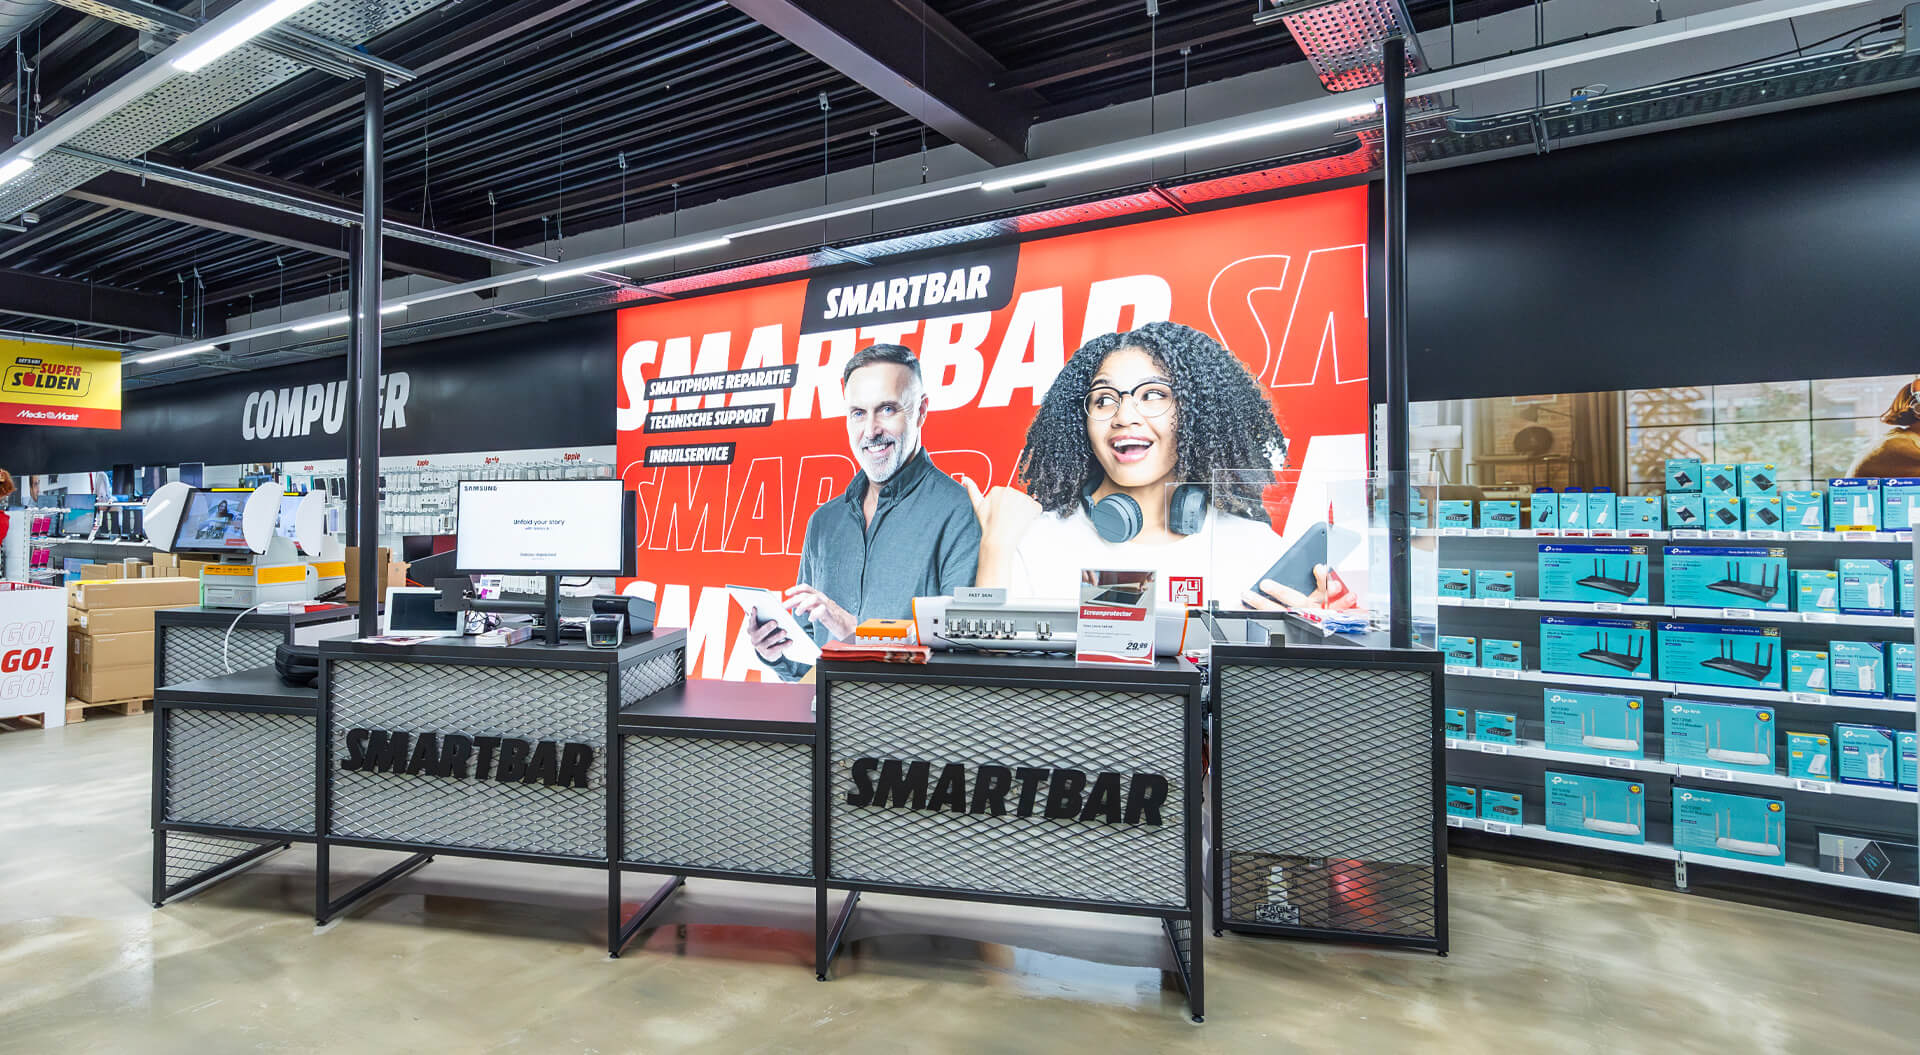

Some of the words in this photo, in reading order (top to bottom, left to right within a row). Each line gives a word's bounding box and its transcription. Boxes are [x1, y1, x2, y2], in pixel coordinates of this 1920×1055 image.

[824, 264, 991, 319] SMARTBAR
[40, 363, 82, 376] SUPER
[649, 375, 725, 396] SMARTPHONE
[725, 369, 792, 389] REPARATIE
[242, 372, 410, 441] COMPUR
[650, 412, 715, 430] TECHNISCHE
[714, 407, 769, 426] SUPPORT
[649, 446, 730, 463] INRUILSERVICE
[1, 619, 55, 647] GO!
[1, 646, 54, 673] GO!
[341, 728, 594, 789] SMARTBAR
[848, 757, 1169, 826] SMARTBAR
